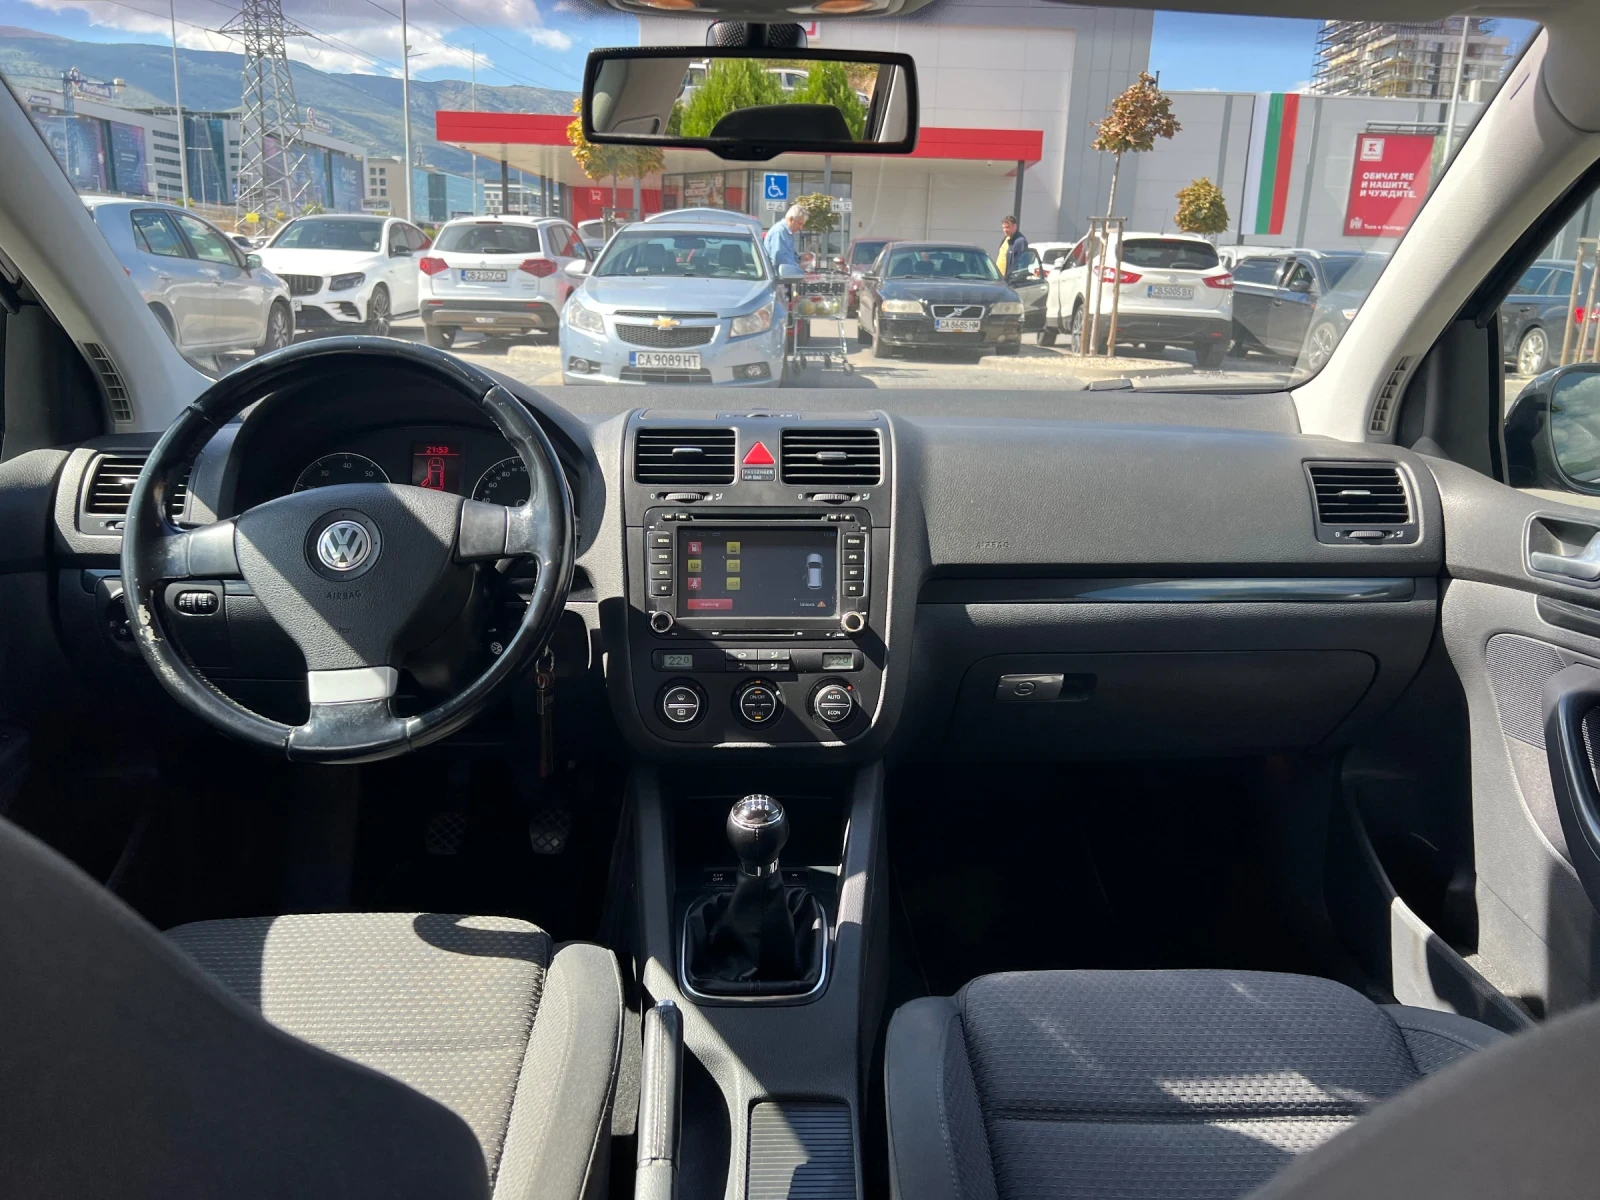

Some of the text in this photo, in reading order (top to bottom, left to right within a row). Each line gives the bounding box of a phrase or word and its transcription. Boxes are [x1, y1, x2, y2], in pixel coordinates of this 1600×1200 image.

[1362, 172, 1414, 181] ОБИЧАТ МЕ
[1361, 181, 1411, 190] И НАШИТЕ,
[1359, 189, 1416, 199] И ЧУЖДИТЕ.
[637, 353, 699, 367] CA 9089 HT
[426, 446, 449, 454] 21:53
[325, 590, 362, 600] AIRBAG
